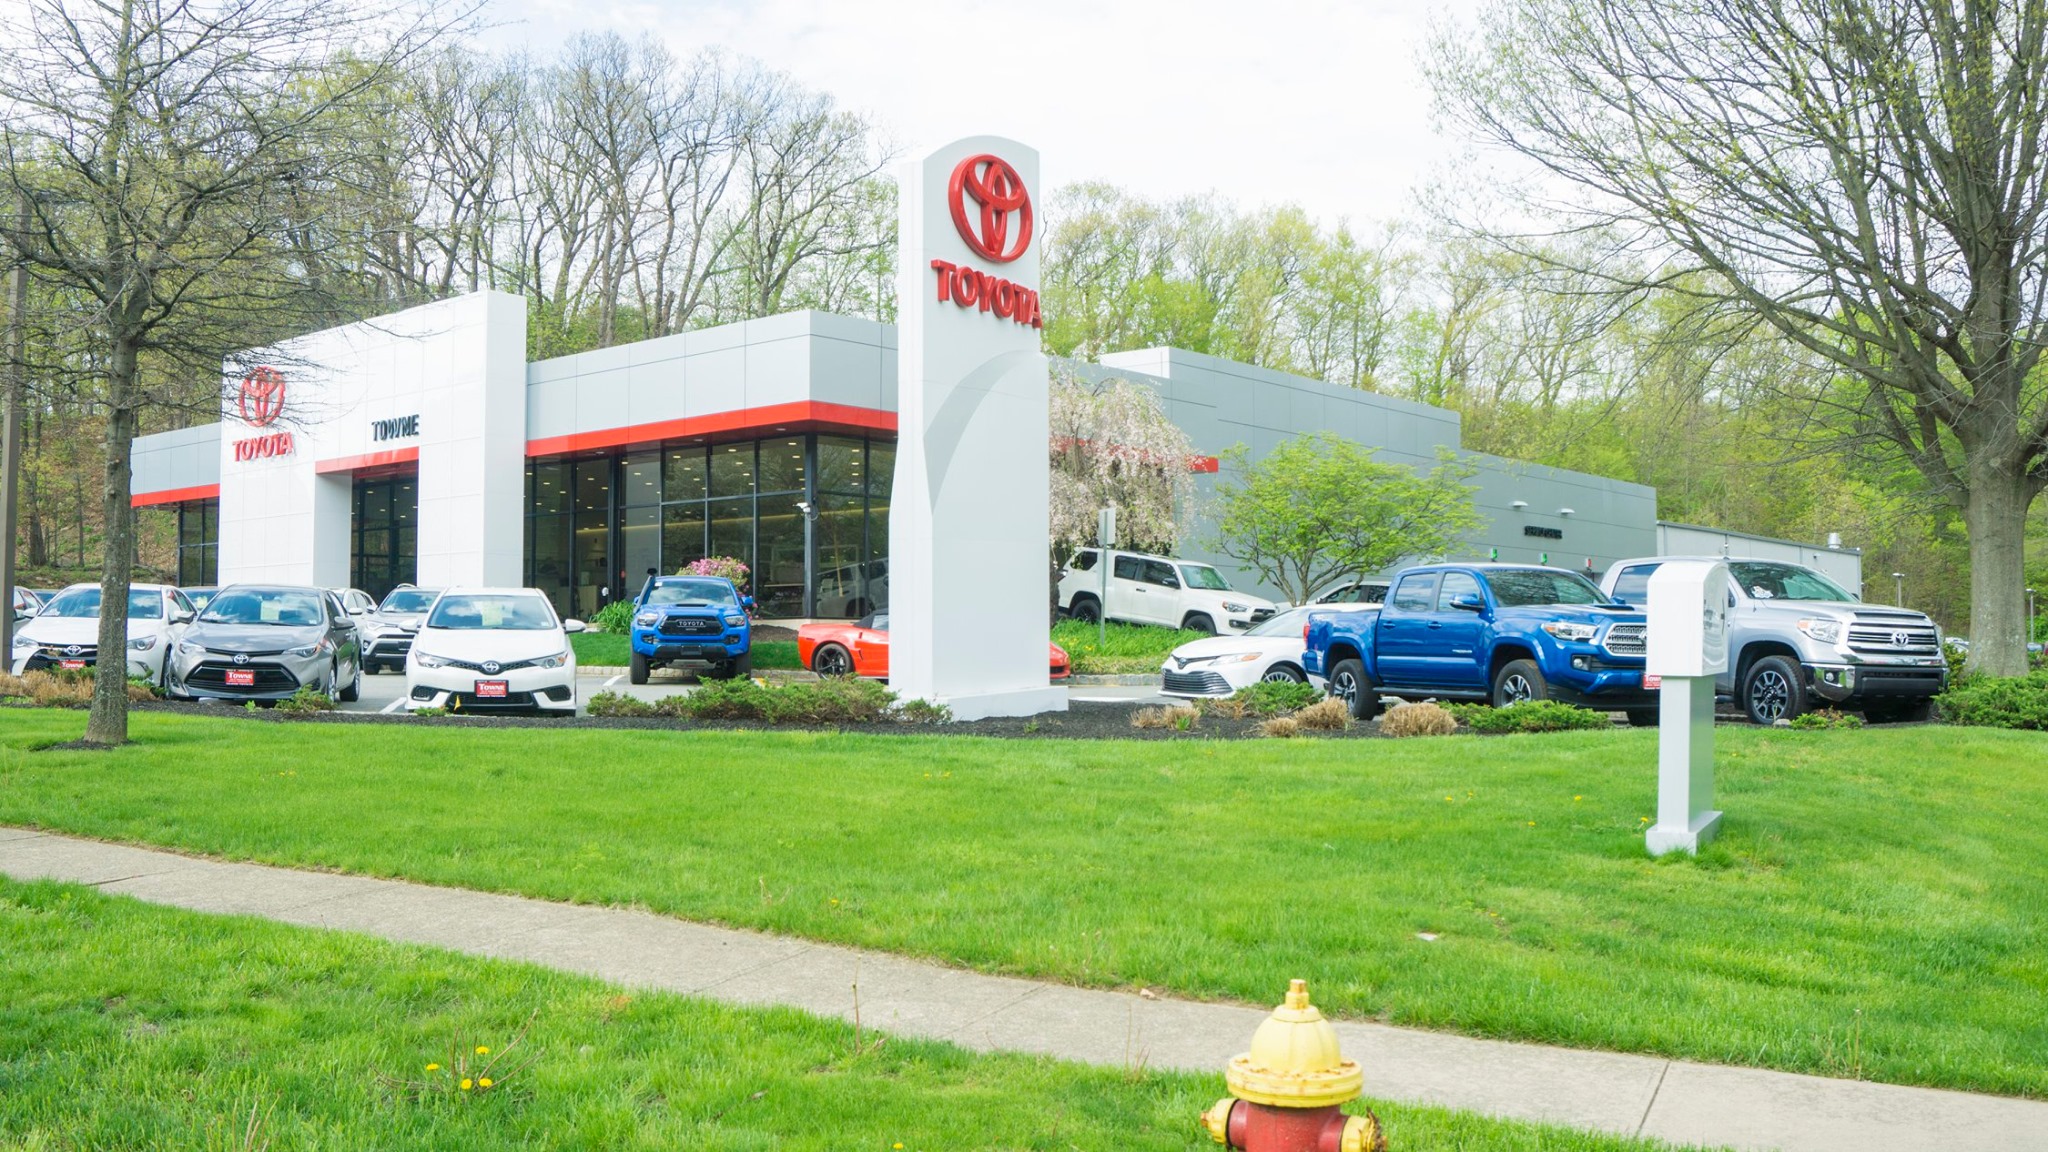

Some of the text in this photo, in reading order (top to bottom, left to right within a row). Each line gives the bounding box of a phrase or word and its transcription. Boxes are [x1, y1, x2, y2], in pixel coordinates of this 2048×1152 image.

[931, 259, 1043, 329] TOYOTA
[372, 414, 419, 441] TOWNE
[232, 432, 294, 461] TOYOTA
